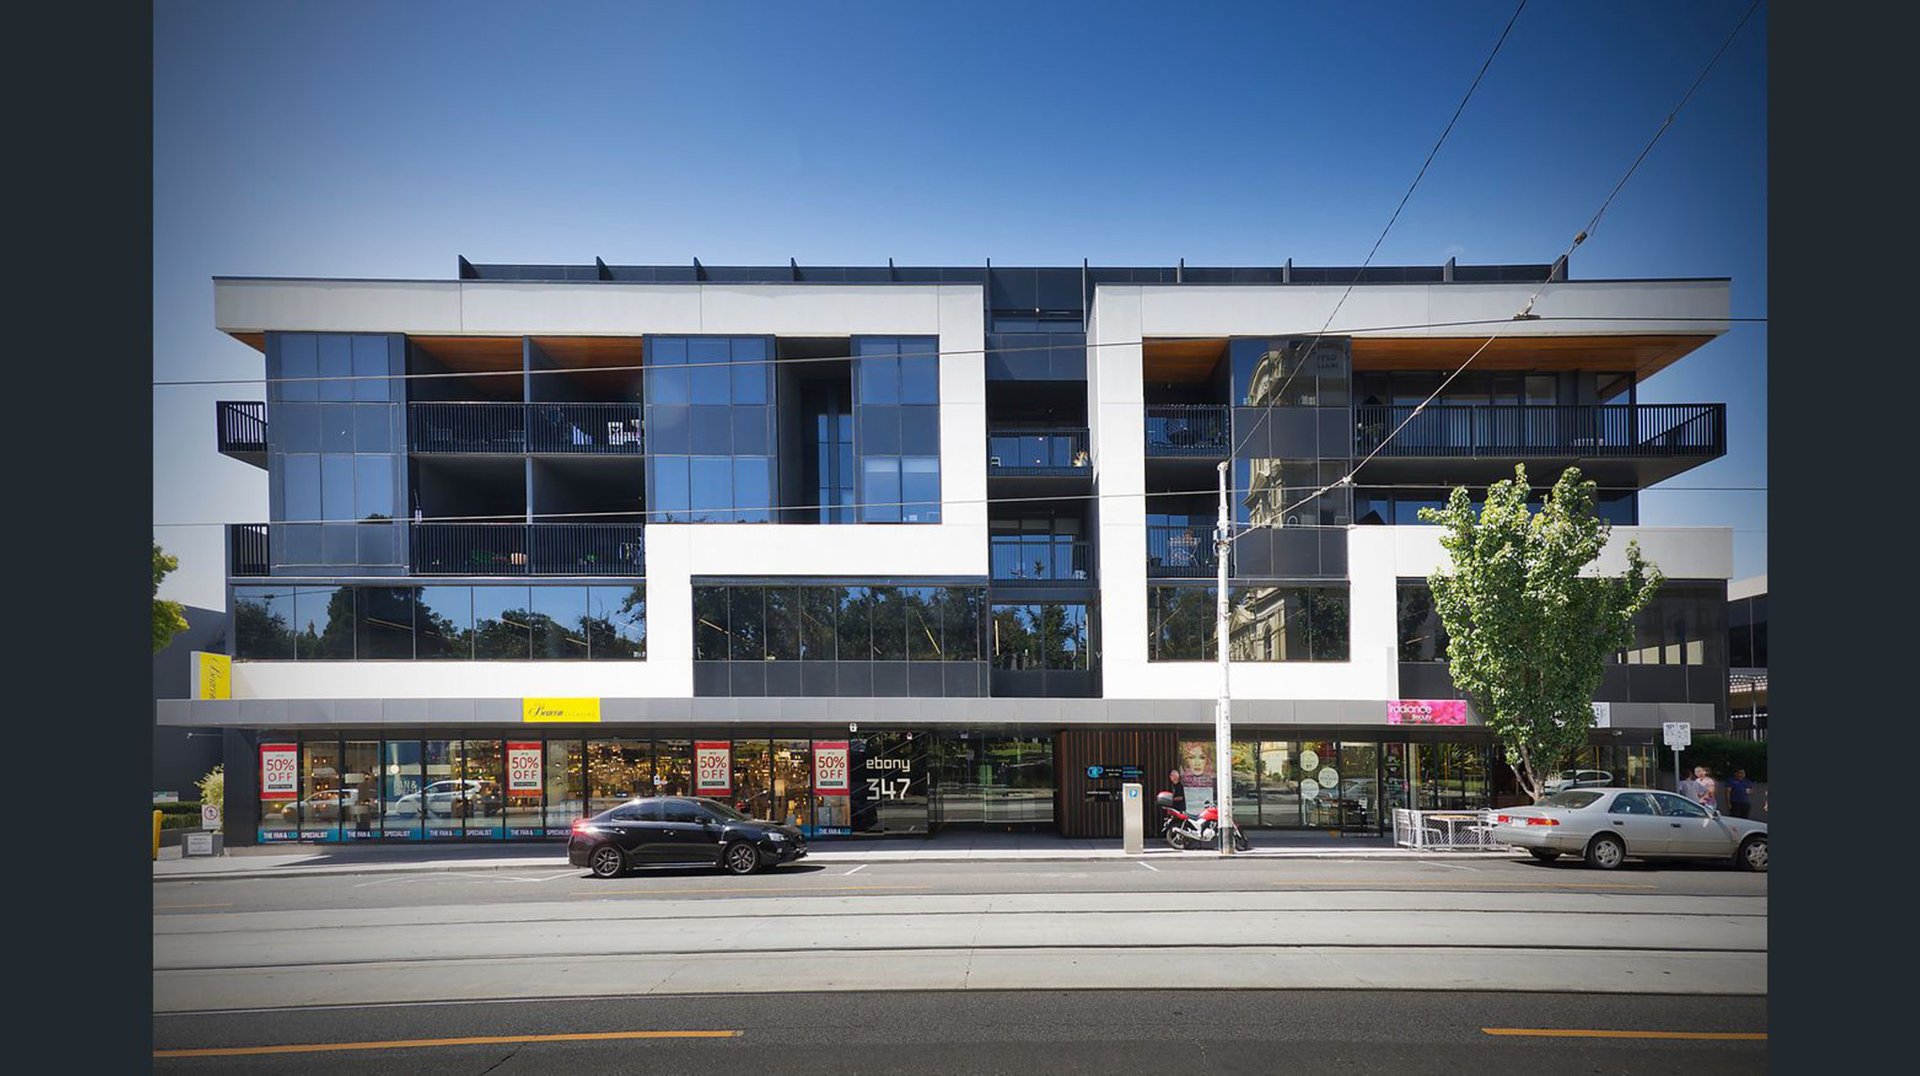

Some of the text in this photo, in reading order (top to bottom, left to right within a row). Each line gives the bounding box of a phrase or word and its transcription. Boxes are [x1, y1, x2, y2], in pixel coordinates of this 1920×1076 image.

[528, 706, 564, 717] Beacon
[1390, 704, 1432, 714] radiance
[266, 758, 295, 771] 50%
[512, 756, 539, 769] 50%
[700, 756, 727, 769] 50%
[818, 756, 845, 769] 50%
[866, 756, 911, 773] ebony
[268, 772, 293, 782] OFF
[513, 770, 537, 780] OFF
[702, 769, 725, 779] OFF
[820, 769, 843, 779] OFF
[866, 778, 911, 800] 347
[301, 831, 328, 839] SPECIALIST
